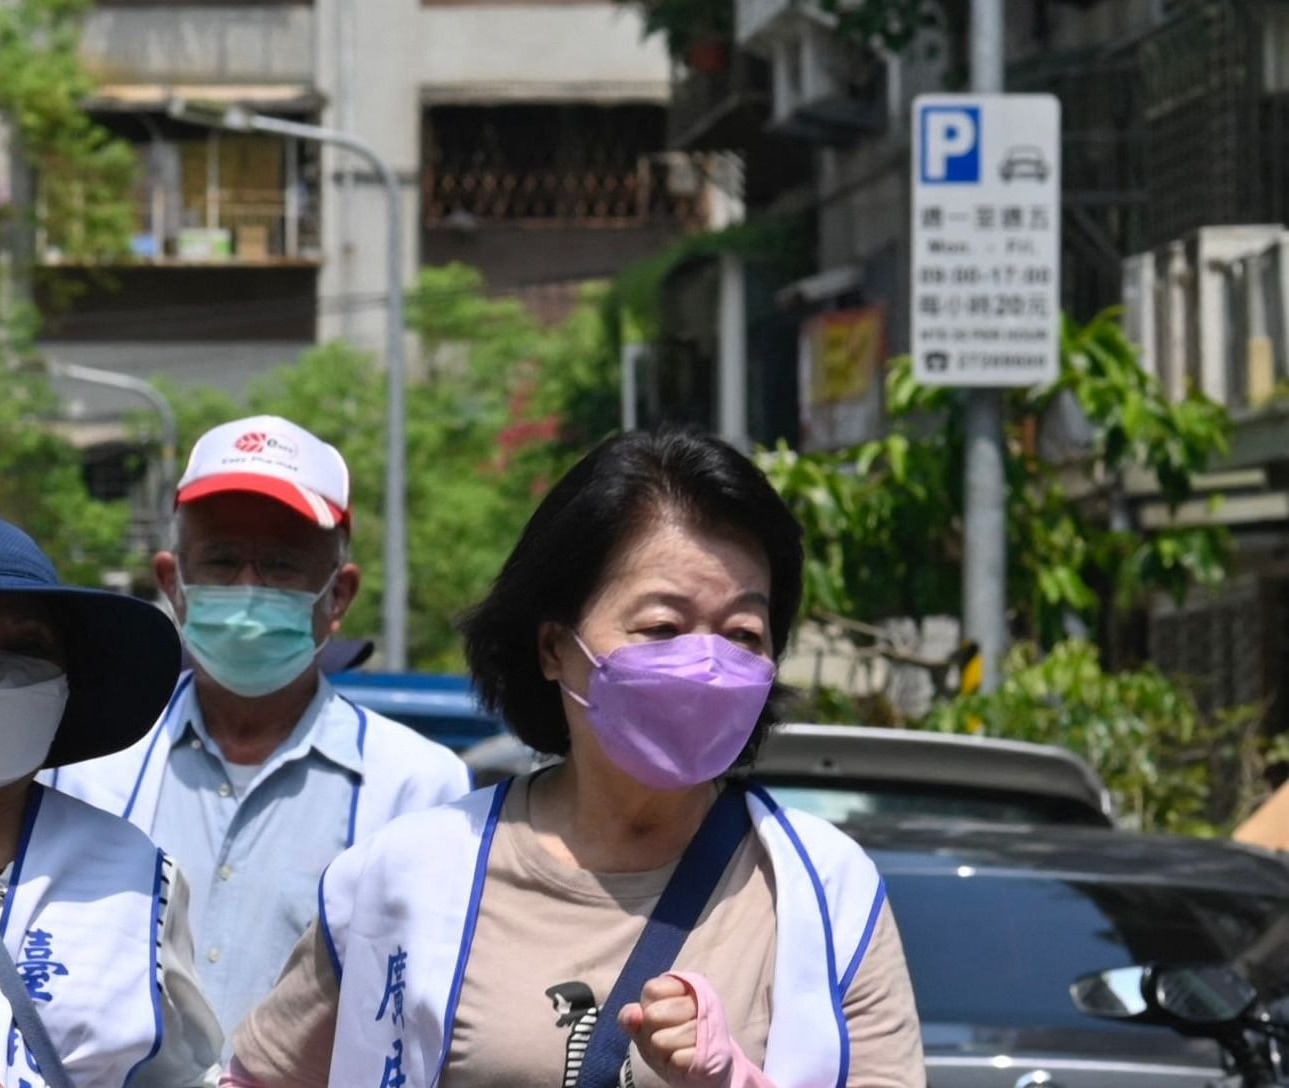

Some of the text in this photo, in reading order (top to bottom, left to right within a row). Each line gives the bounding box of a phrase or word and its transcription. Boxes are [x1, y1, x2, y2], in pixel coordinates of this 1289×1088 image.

[926, 111, 977, 180] P
[921, 206, 1049, 230] 週一至週五
